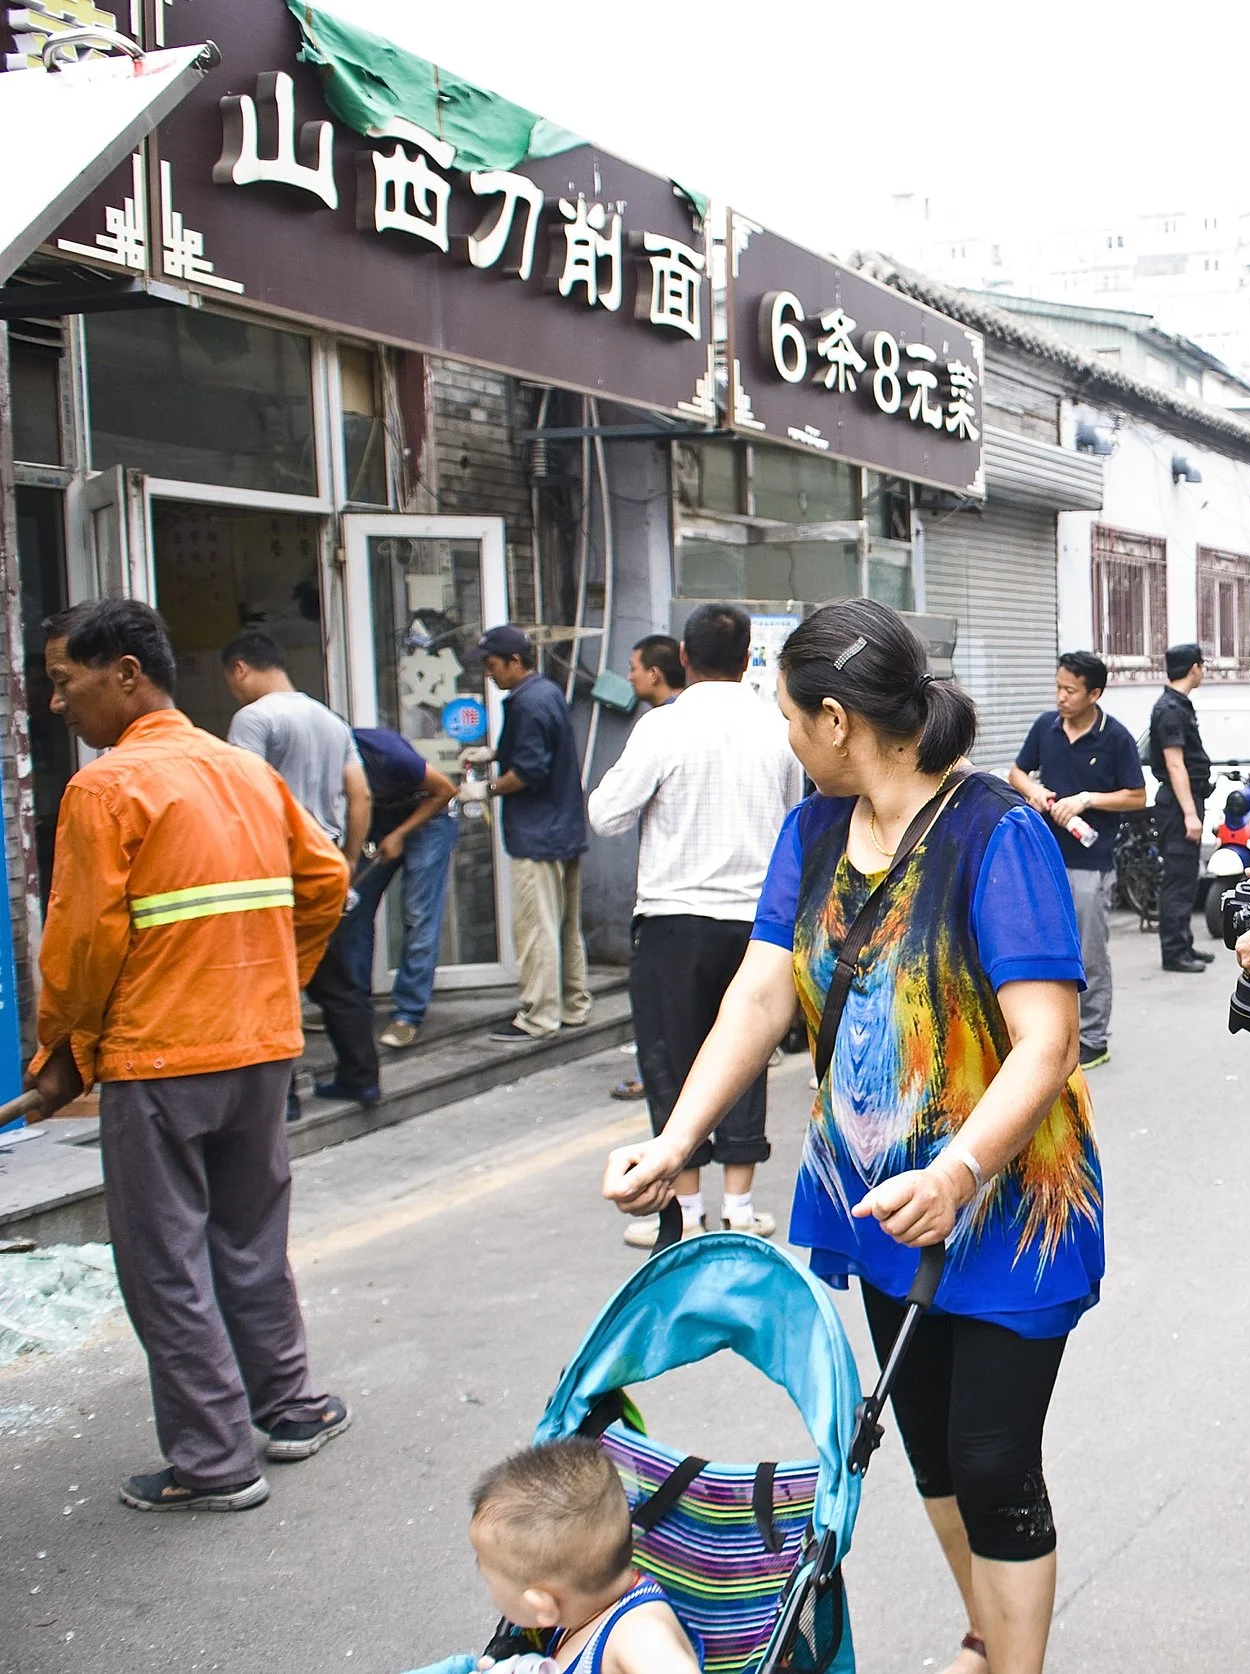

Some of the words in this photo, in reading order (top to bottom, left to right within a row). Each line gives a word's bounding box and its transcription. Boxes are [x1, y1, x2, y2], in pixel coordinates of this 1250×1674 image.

[230, 70, 705, 341] 山西刀削面
[770, 290, 981, 442] 6条8元菜
